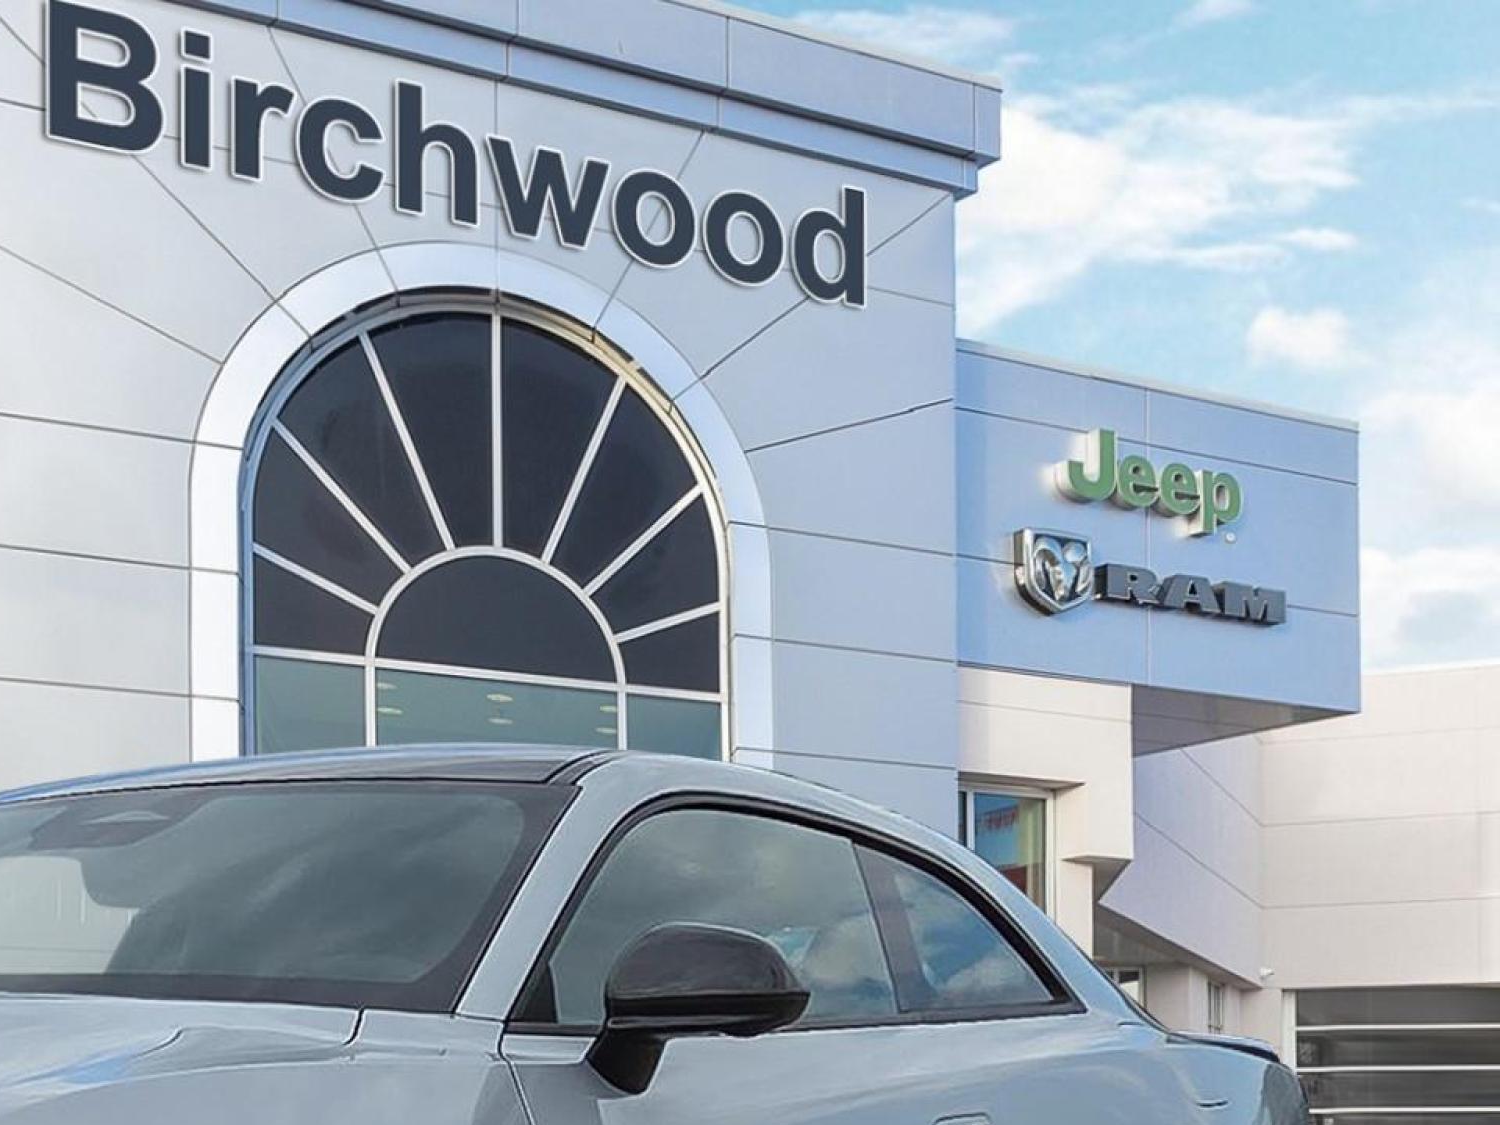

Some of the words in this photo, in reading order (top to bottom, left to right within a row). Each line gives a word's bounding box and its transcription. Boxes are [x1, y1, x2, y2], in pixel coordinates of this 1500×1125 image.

[44, 0, 866, 308] Birchwood
[1055, 428, 1242, 536] Jeep
[1095, 563, 1286, 626] RAM
